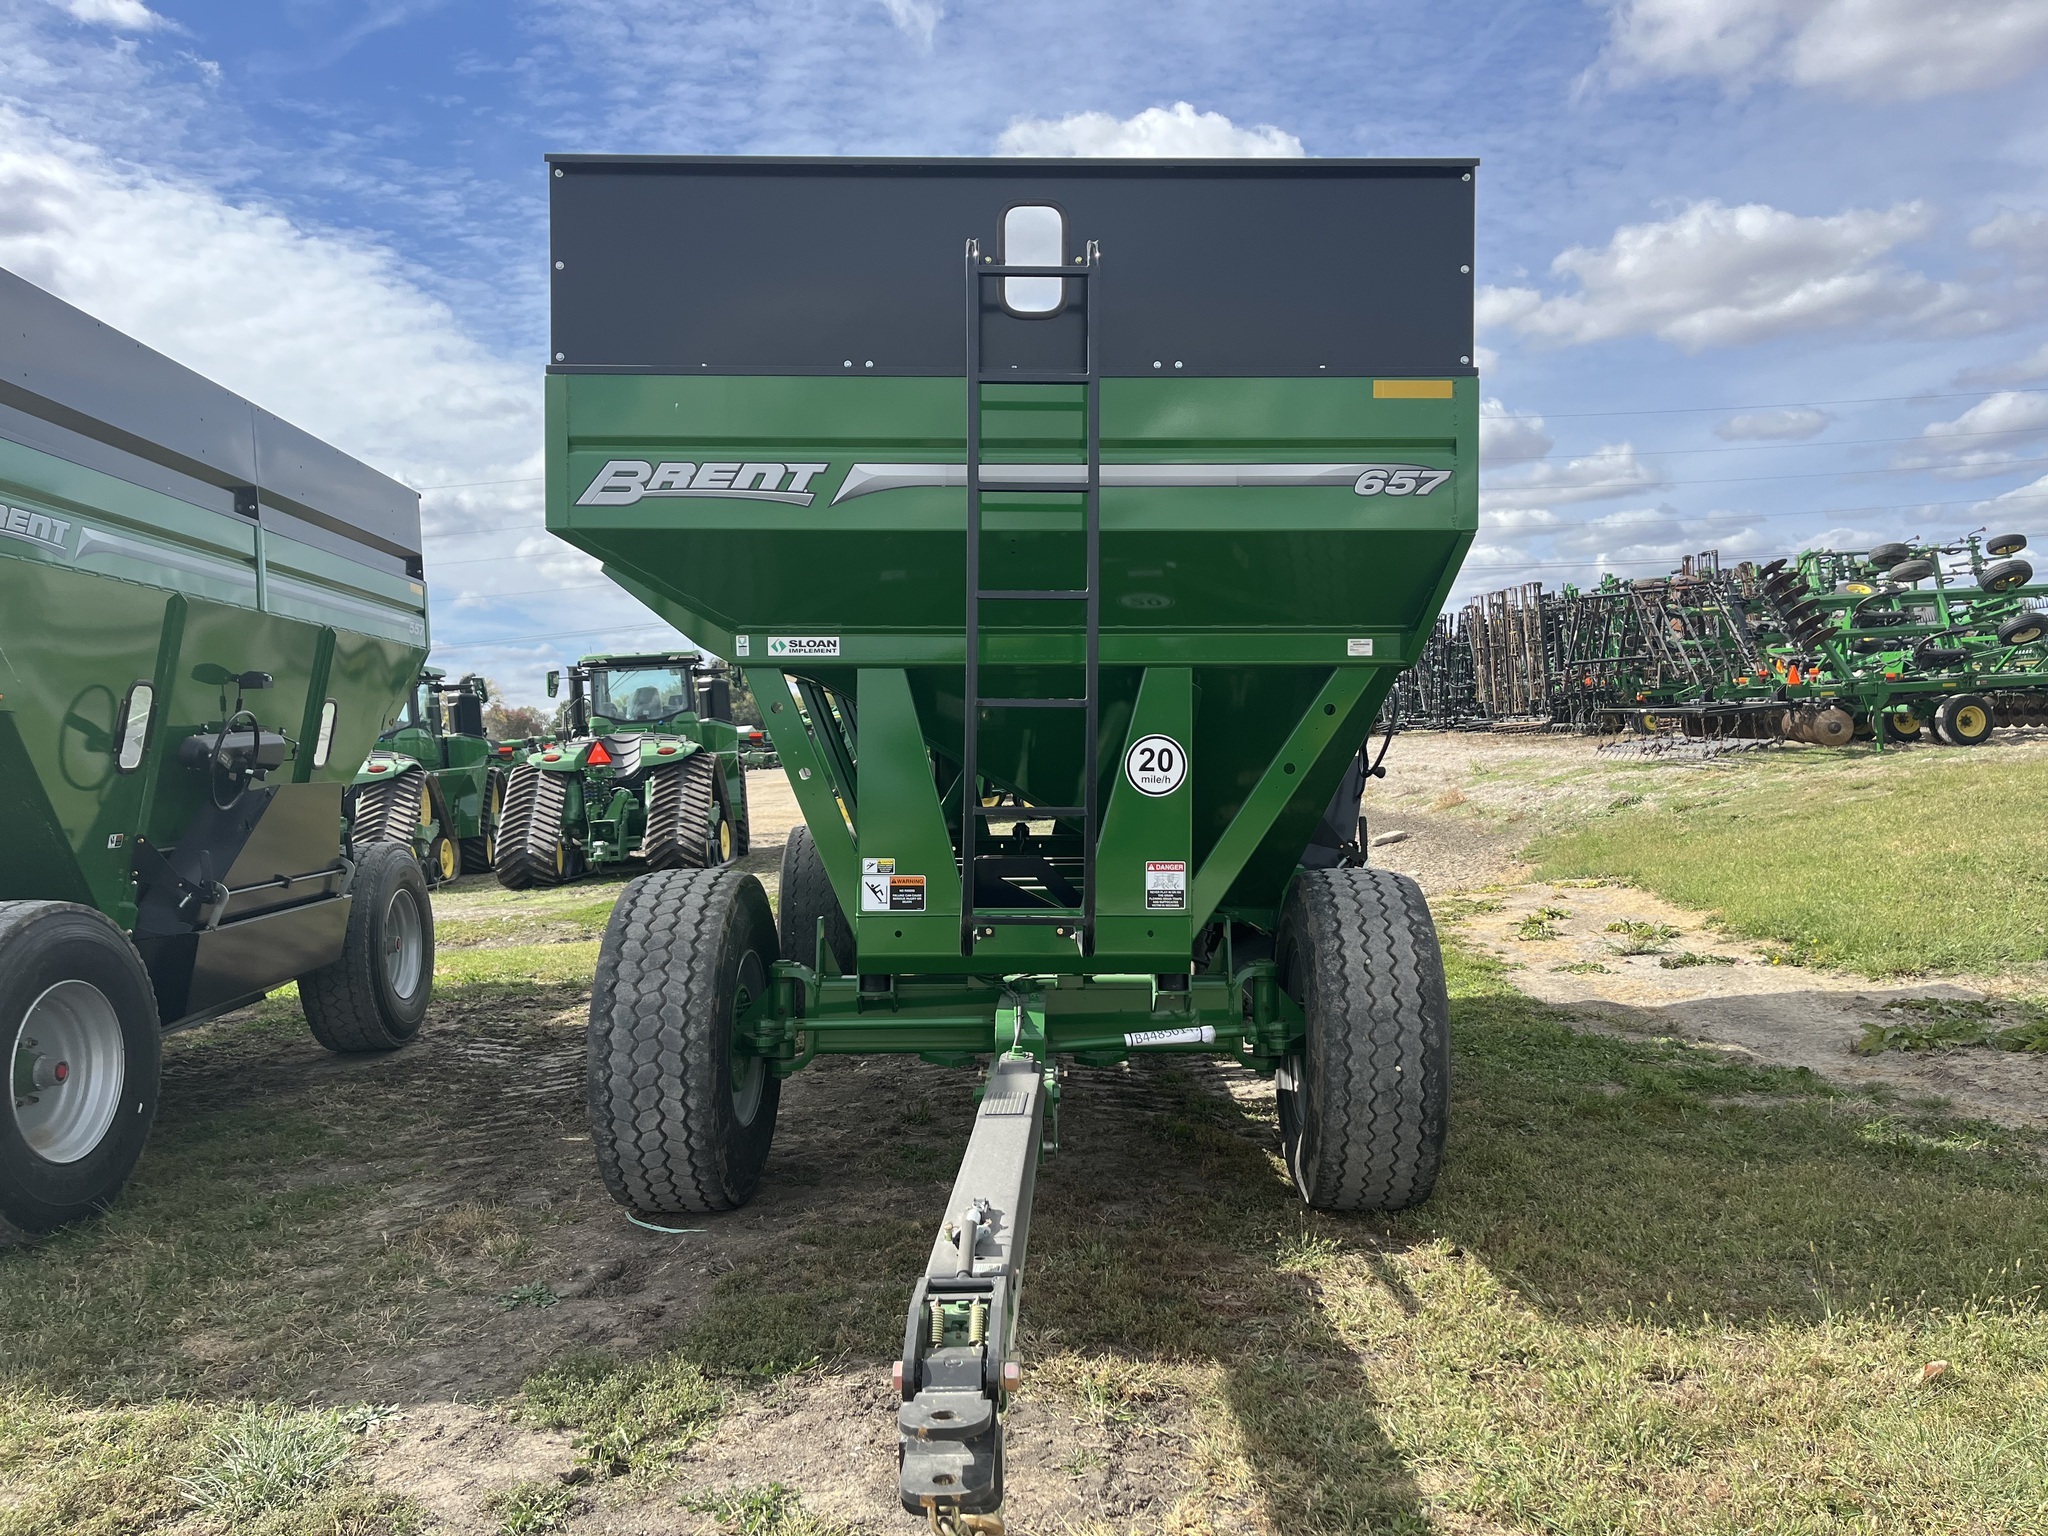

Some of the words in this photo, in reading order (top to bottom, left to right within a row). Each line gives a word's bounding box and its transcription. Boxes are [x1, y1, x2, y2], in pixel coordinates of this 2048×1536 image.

[573, 459, 831, 507] BRENT
[1353, 470, 1454, 496] 657
[408, 621, 425, 637] 557
[788, 640, 837, 648] SLOAN
[1138, 747, 1174, 773] 20
[1141, 775, 1171, 784] mile/h
